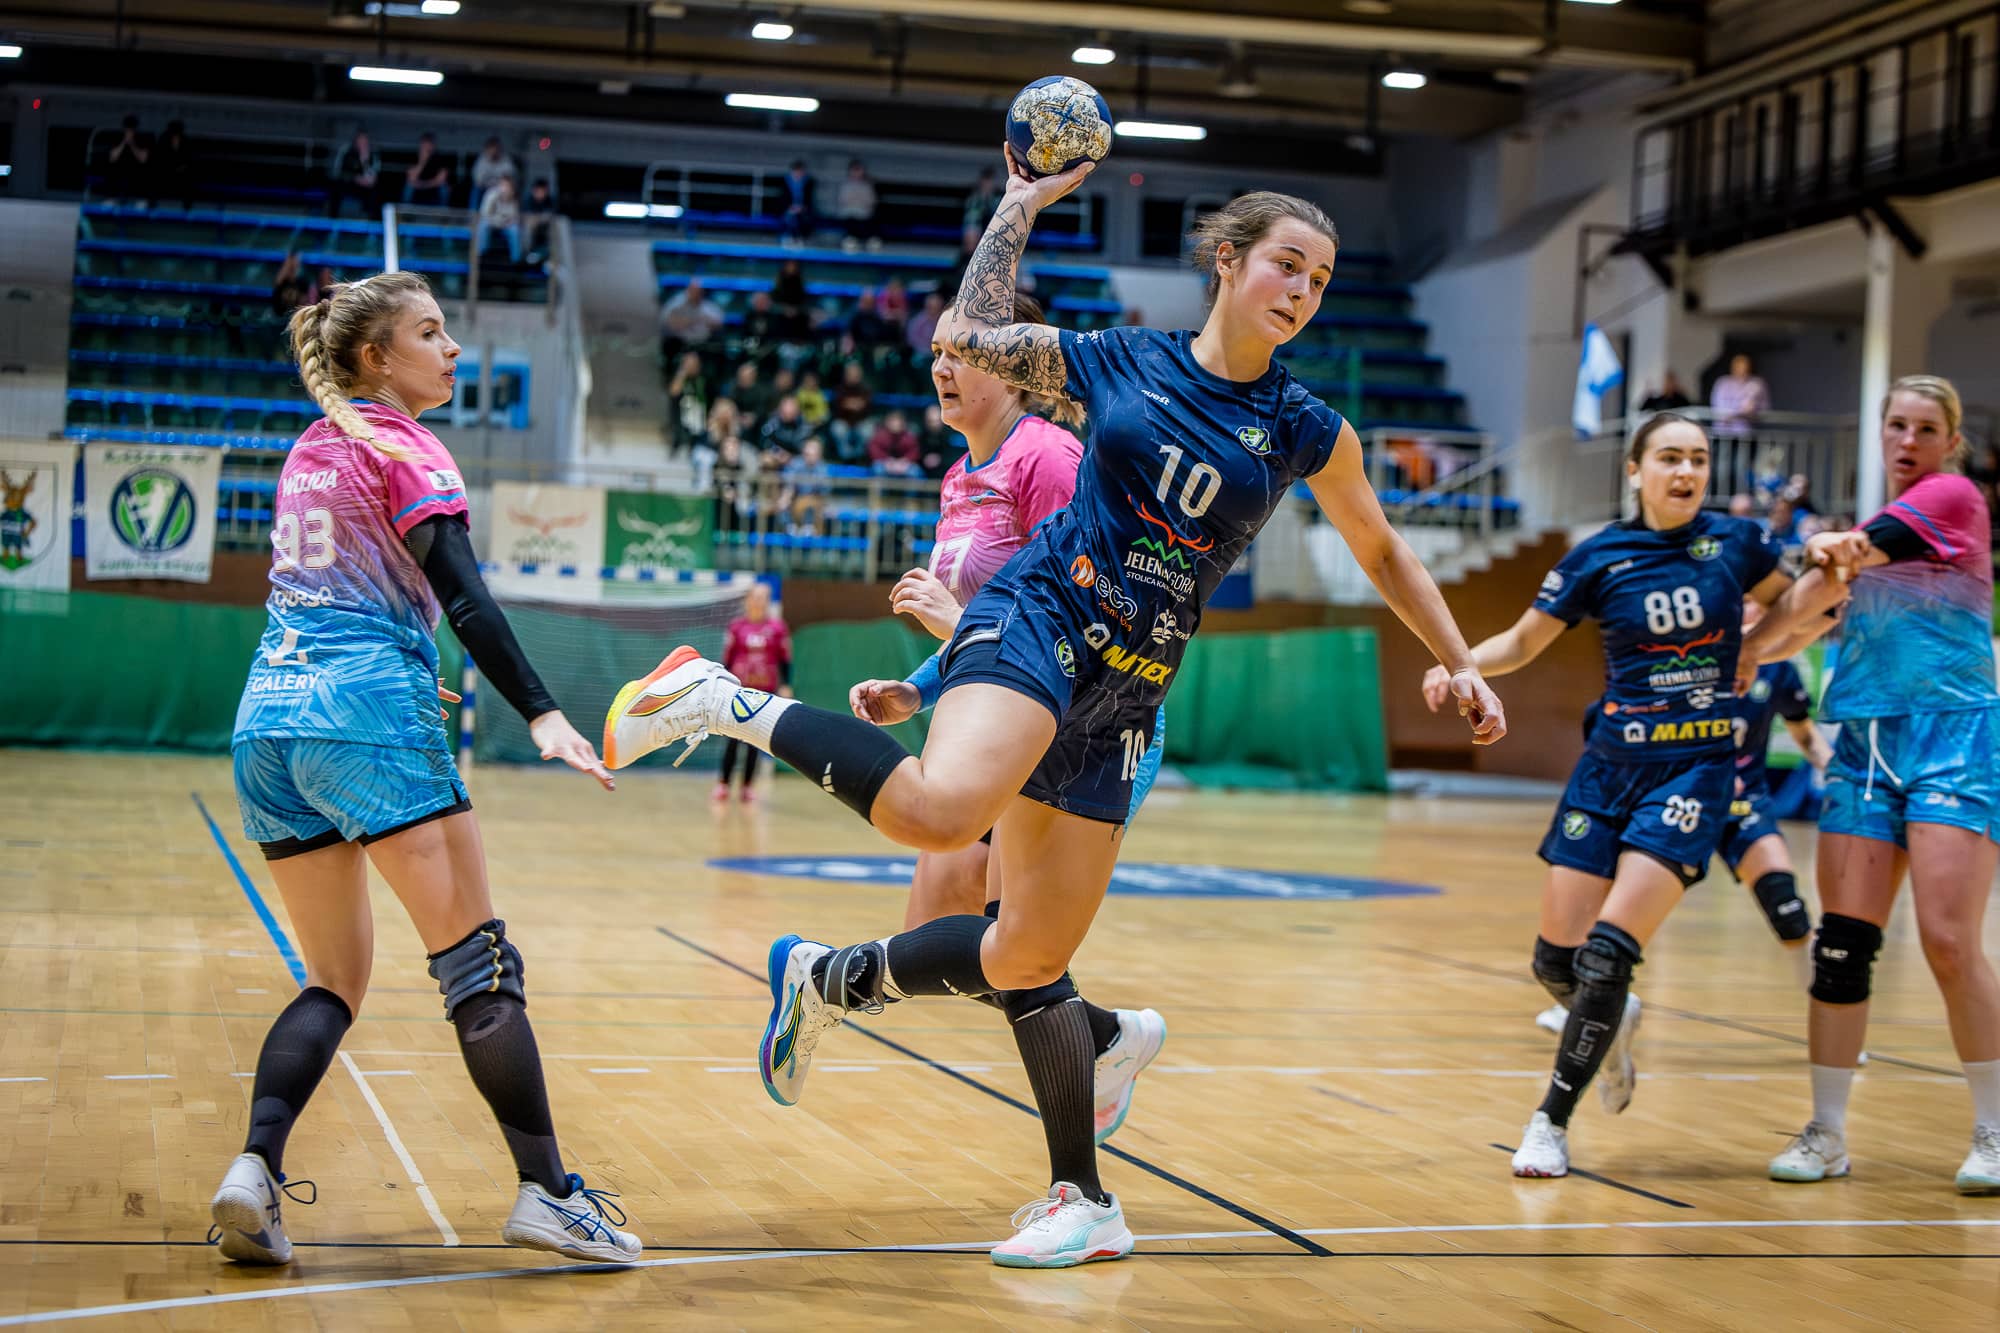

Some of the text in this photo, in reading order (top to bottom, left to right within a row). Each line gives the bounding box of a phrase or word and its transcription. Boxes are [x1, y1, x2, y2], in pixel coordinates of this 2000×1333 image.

[1156, 445, 1222, 518] 10
[270, 507, 336, 572] 93
[1126, 571, 1156, 586] STOLICA
[1644, 586, 1705, 635] 88
[252, 672, 321, 692] GALERY
[1120, 729, 1146, 781] 10
